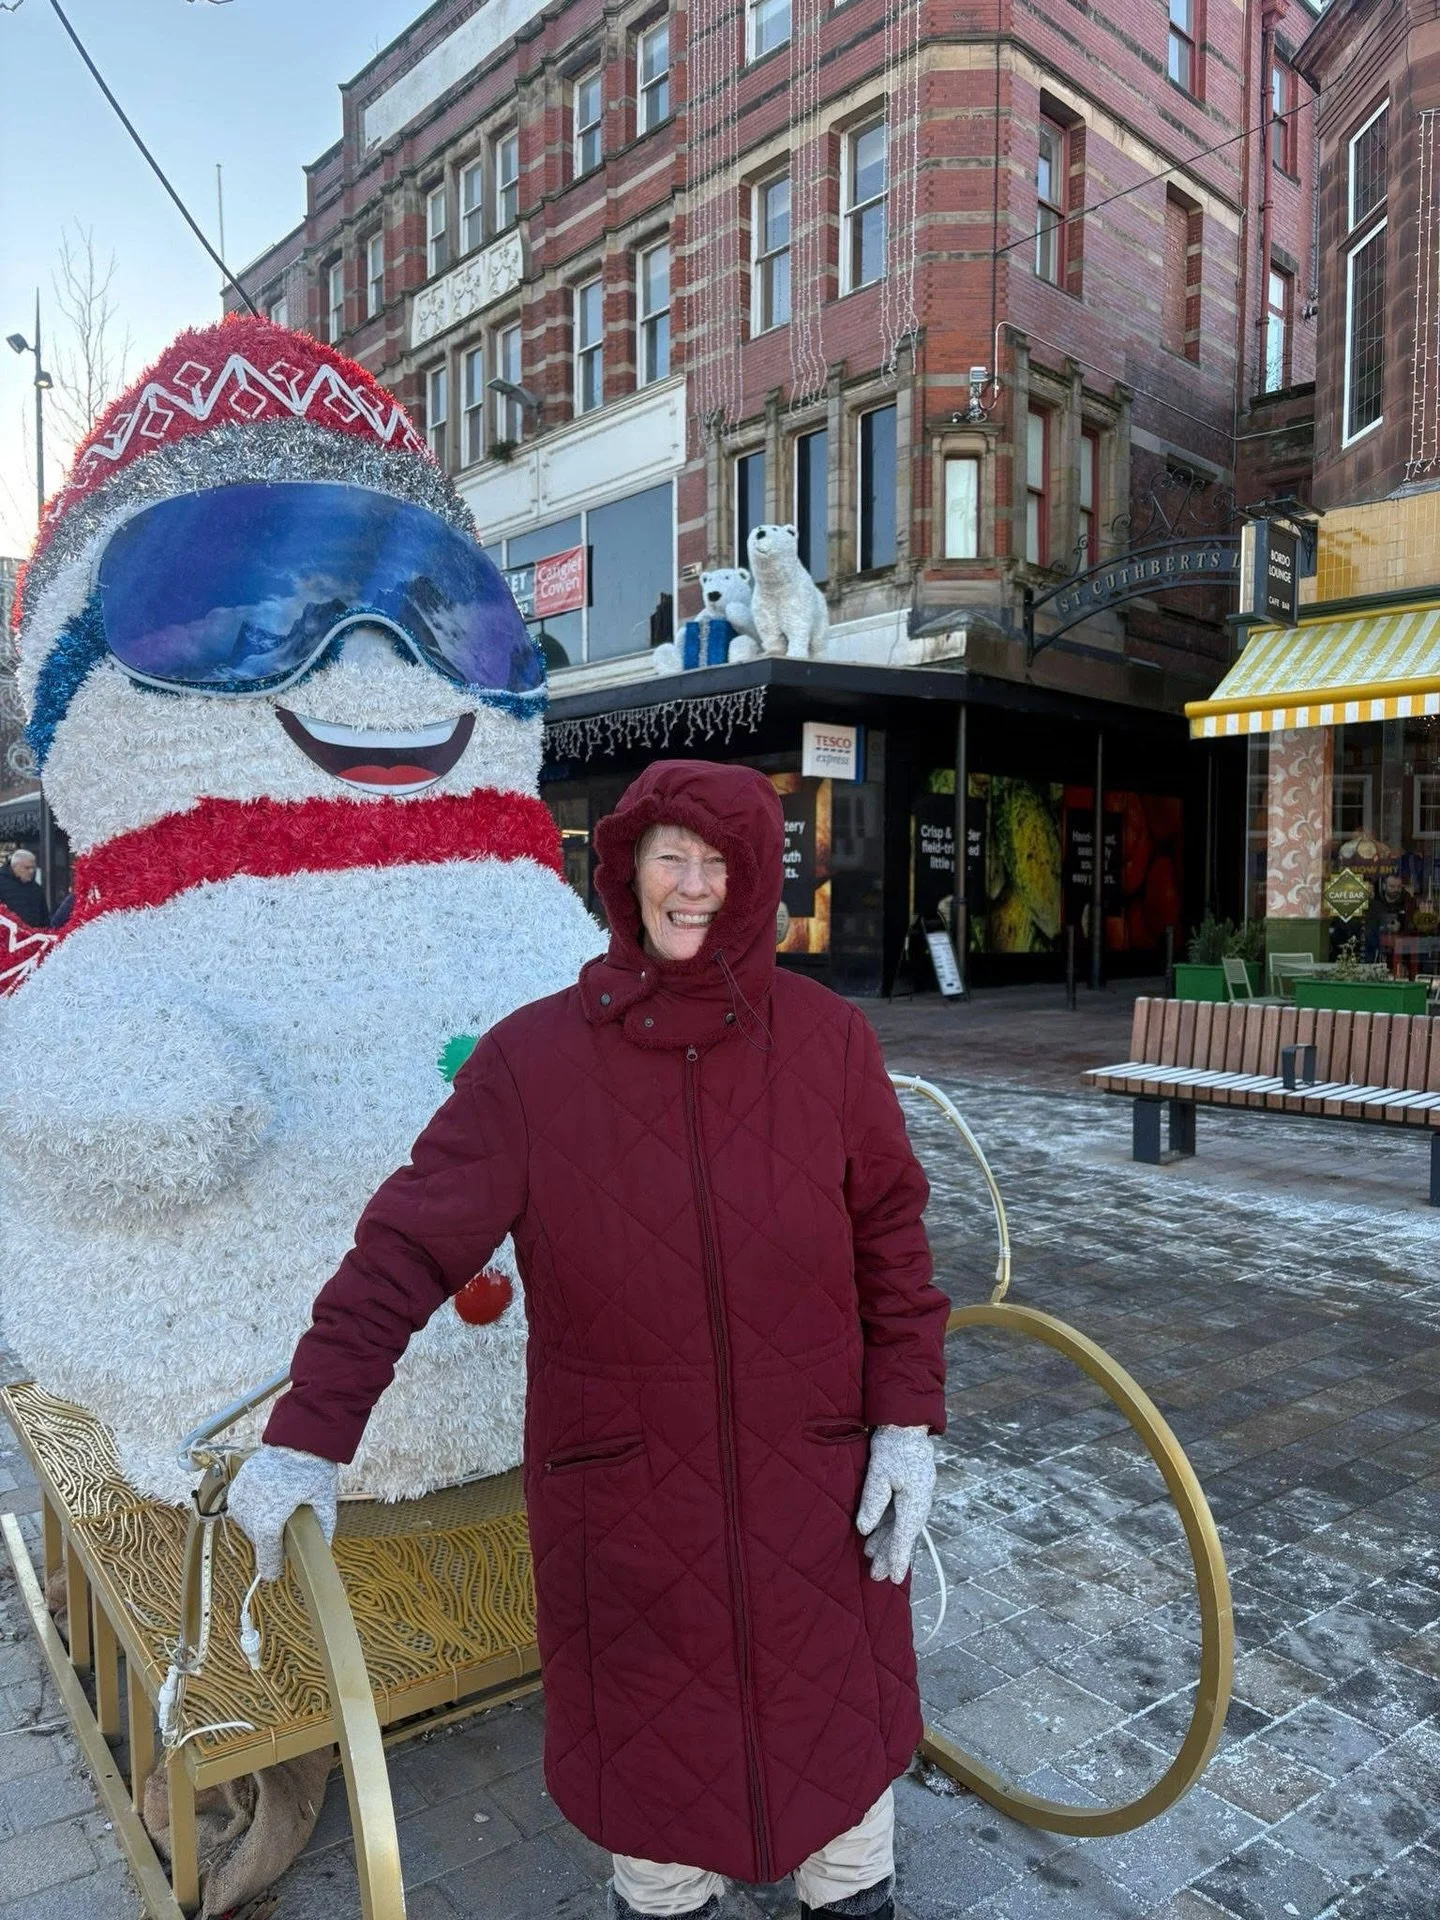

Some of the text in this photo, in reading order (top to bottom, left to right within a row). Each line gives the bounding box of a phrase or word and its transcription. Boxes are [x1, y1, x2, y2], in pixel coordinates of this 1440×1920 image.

[1270, 549, 1290, 567] BORDO
[1092, 552, 1221, 595] CUTHBERTS
[1268, 564, 1292, 584] LOUNGE
[540, 577, 581, 598] Cowen
[815, 735, 852, 749] TESCO
[816, 754, 850, 767] express
[920, 824, 944, 842] Crisp
[945, 826, 953, 840] &
[783, 850, 802, 864] uth
[929, 855, 950, 870] little
[1349, 891, 1365, 899] BAR
